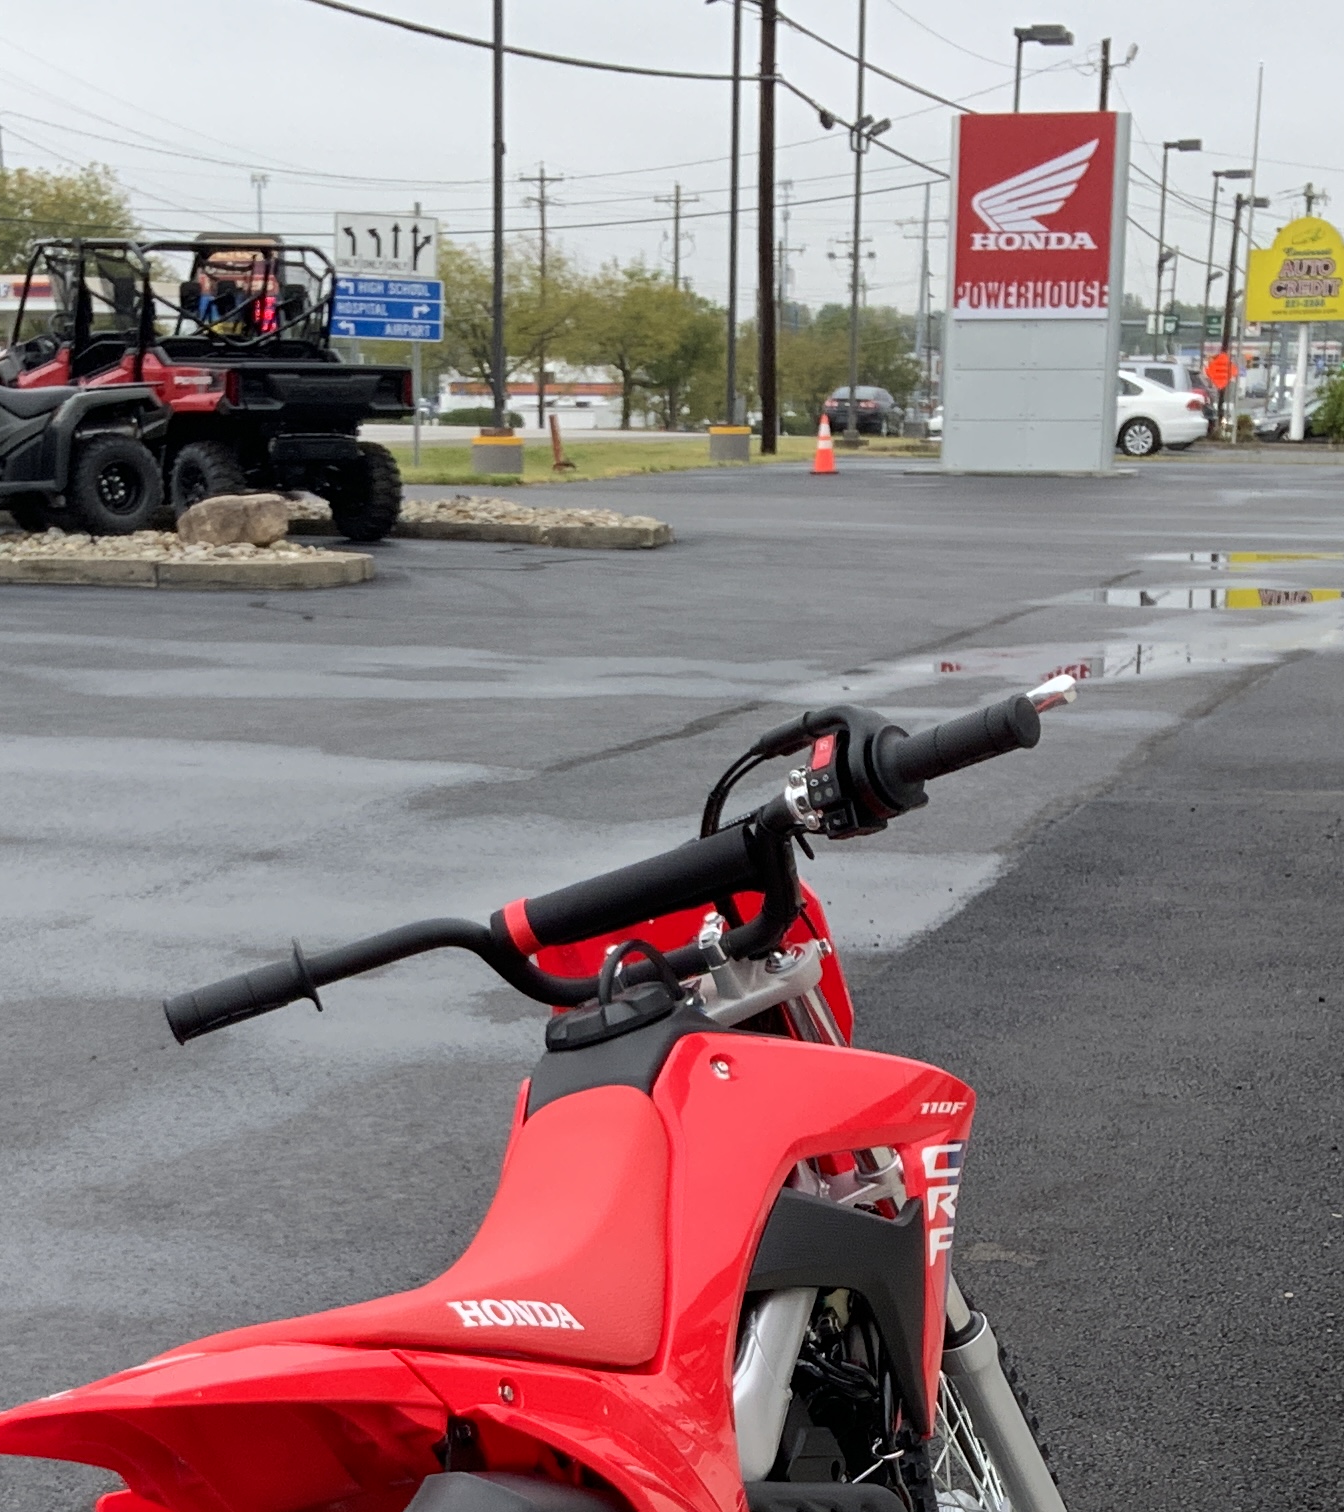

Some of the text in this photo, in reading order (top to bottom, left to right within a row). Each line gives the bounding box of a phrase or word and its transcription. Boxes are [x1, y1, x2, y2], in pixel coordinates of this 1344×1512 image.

[970, 232, 1098, 251] HONDA
[1278, 257, 1336, 278] AUTO
[358, 282, 431, 296] HIGH SCHOOL
[954, 280, 1109, 309] POWERHOUSE
[1270, 278, 1343, 298] CREDIT
[337, 302, 388, 316] HOSPITAL
[385, 323, 430, 336] AIRPORT
[920, 1101, 967, 1116] 110F
[921, 1143, 963, 1267] CRF
[445, 1299, 585, 1330] HONDA
